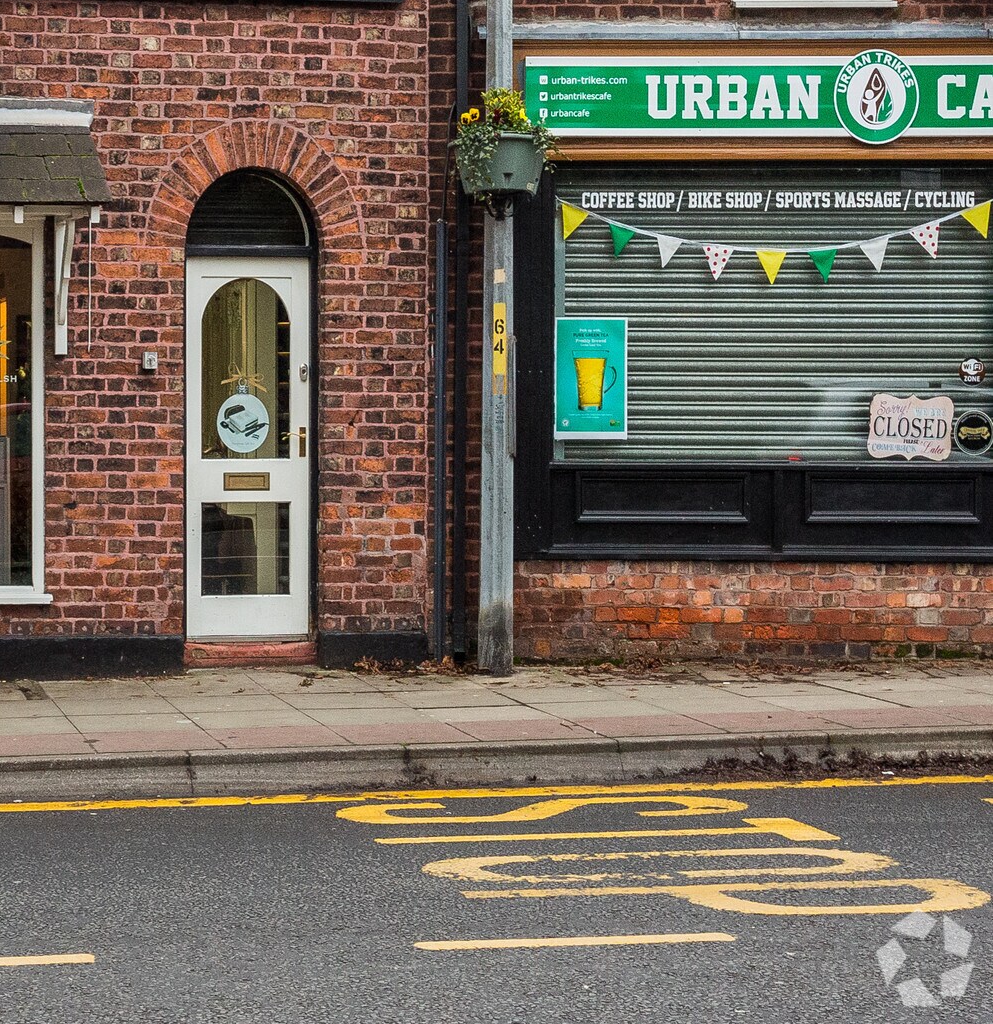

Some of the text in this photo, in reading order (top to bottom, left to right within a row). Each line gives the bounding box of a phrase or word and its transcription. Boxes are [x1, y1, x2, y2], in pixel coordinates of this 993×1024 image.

[551, 75, 628, 85] urban-trikes.com
[837, 52, 915, 94] URBAN TRIKES
[550, 91, 612, 101] urbantrikescafe
[645, 74, 993, 120] URBAN CA
[550, 108, 591, 118] urbancafe
[581, 192, 635, 209] COFFEE
[688, 192, 722, 209] BIKE
[775, 191, 831, 208] SPORTS
[914, 191, 975, 208] CYCLING
[963, 375, 981, 383] ZONE
[873, 416, 948, 439] CLOSED
